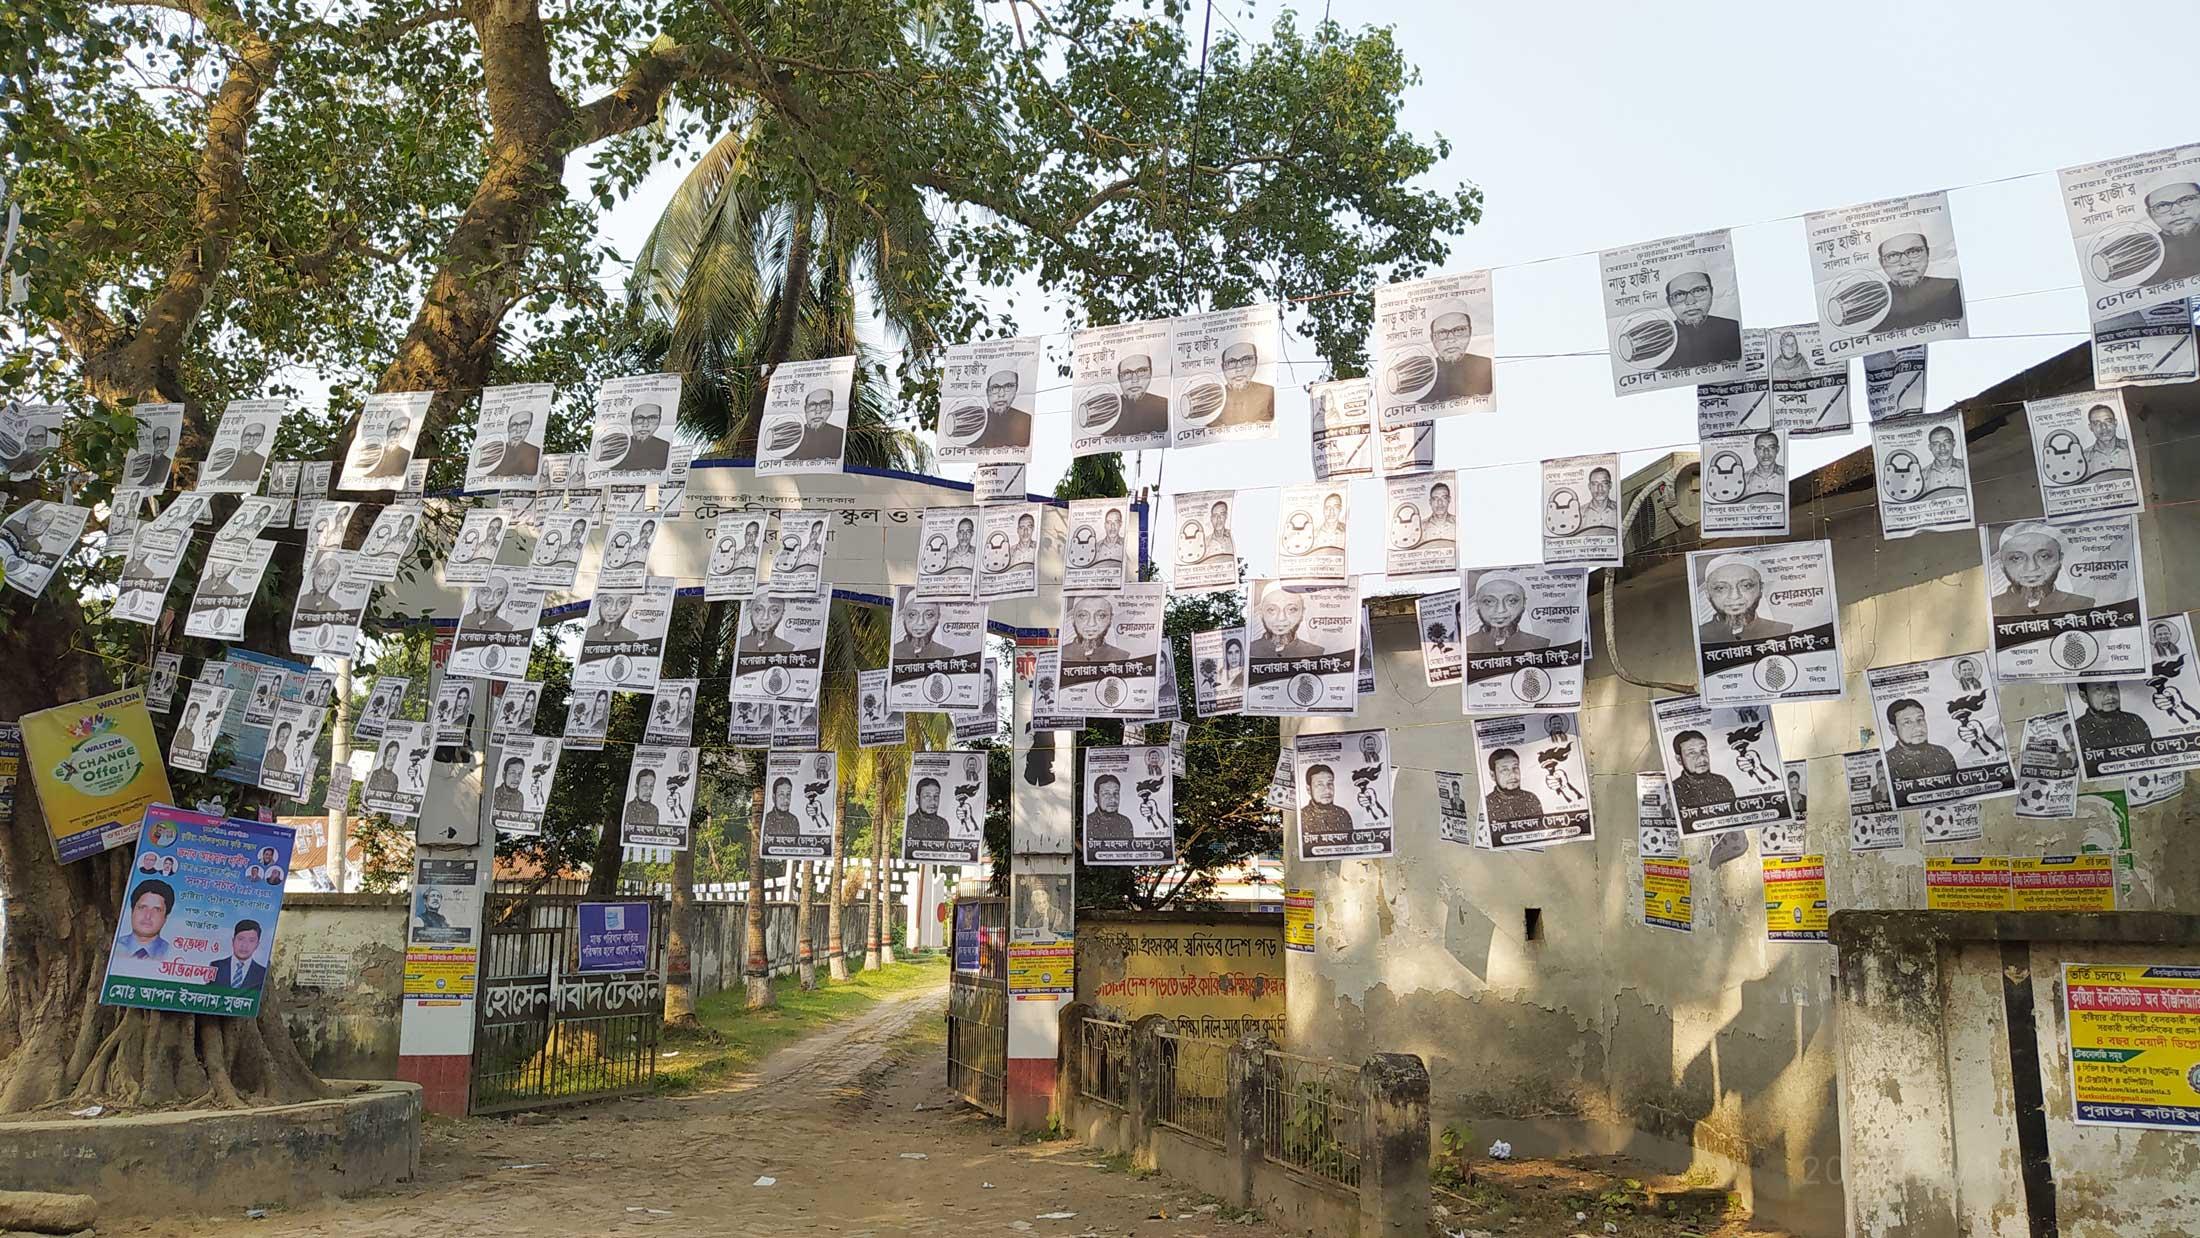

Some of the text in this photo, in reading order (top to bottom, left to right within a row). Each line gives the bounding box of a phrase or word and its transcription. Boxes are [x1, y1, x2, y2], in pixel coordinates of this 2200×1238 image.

[2072, 194, 2095, 212] নাড়ু
[2082, 205, 2136, 225] সালাম নিন
[1815, 240, 1835, 258] নাড়ু
[1823, 252, 1869, 270] সালাম নিন
[1608, 276, 1626, 295] নাড়ু
[1615, 290, 1657, 307] সালাম নিন
[2096, 279, 2185, 310] ঢোল মার্কায়
[1386, 328, 1423, 342] সালাম নিন
[1829, 320, 1960, 353] ঢোল মার্কায় ভোট দিন
[2102, 340, 2141, 353] কলম
[1619, 361, 1738, 387] ঢোল মার্কায় ভোট দিন
[1385, 403, 1418, 418] ঢোল
[1420, 401, 1445, 412] মার্কায়
[1473, 396, 1488, 405] দিন
[1700, 396, 1728, 408] কলম
[1778, 393, 1808, 405] কলম
[1075, 437, 1102, 449] ঢোল
[1150, 432, 1165, 441] দিন
[1177, 427, 1206, 441] ঢোল
[939, 446, 966, 457] ঢোল
[816, 497, 856, 505] সরকার
[2070, 558, 2129, 578] চেয়ারম্যান
[1770, 586, 1824, 606] চেয়ারম্যান
[1531, 604, 1580, 621] চেয়ারম্যান
[1997, 619, 2050, 636] মনোয়ার
[2053, 613, 2087, 629] কবীর
[1705, 646, 1752, 662] মনোয়ার
[1756, 639, 1788, 653] কবীর
[1251, 658, 1318, 674] মনোয়ার কবীর
[1470, 655, 1512, 670] মনোয়ার
[1515, 650, 1543, 665] কবীর
[1063, 663, 1123, 677] মনোয়ার কবীর
[97, 692, 139, 709] WALTON
[84, 738, 122, 753] WALTON
[2084, 749, 2104, 761] চাঁদ
[2102, 752, 2199, 772] মশাল মার্কায় ভোট দিন
[1894, 779, 1913, 791] চাঁদ
[1680, 805, 1699, 819] চাঁদ
[1742, 813, 1759, 822] ভোট
[1491, 821, 1508, 832] চাঁদ
[1303, 829, 1320, 845] চাঁদ
[173, 936, 219, 953] শুভেচ্ছা ও
[1225, 938, 1251, 957] দেশ
[1254, 938, 1276, 959] গড়
[2070, 968, 2091, 981] ভর্তি
[1127, 977, 1146, 996] দেশ
[109, 984, 253, 1011] মোঃ আপন ইসলাম সুজন
[2070, 988, 2094, 1009] কুষ্টিয়া
[2143, 992, 2159, 1008] অব
[2109, 1037, 2129, 1047] বছর
[2082, 1105, 2135, 1118] পুরাতন
